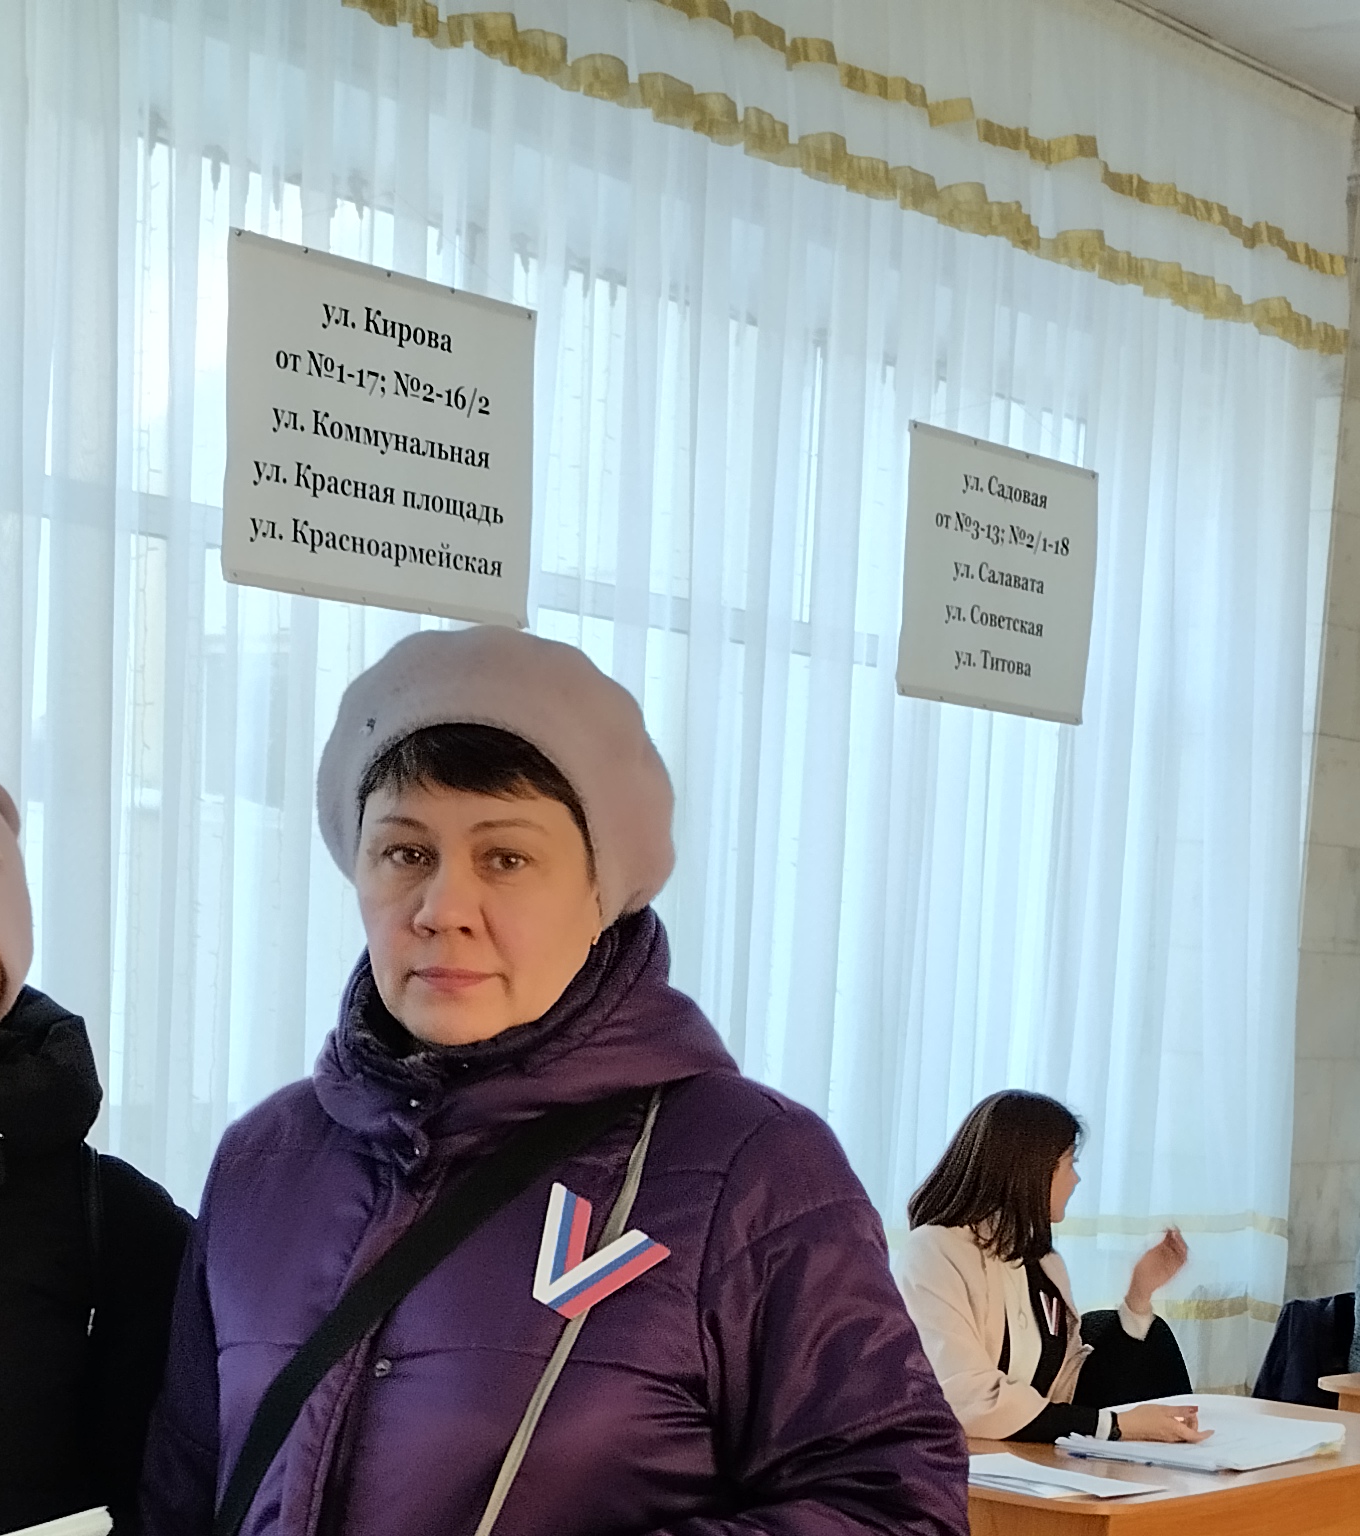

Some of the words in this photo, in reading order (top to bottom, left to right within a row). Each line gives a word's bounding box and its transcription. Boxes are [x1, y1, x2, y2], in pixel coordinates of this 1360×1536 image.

[321, 303, 356, 330] ул.
[364, 306, 453, 354] Кирова
[275, 350, 302, 373] от
[272, 407, 305, 433] ул.
[312, 409, 491, 470] Коммунальная
[252, 460, 288, 487] ул.
[294, 461, 396, 506] Красная
[402, 490, 504, 526] площадь
[962, 474, 984, 494] ул.
[987, 475, 1048, 510] Садовая
[935, 512, 952, 529] от
[249, 517, 284, 543] ул.
[291, 517, 503, 578] Красноармейская
[952, 561, 975, 582] ул.
[978, 561, 1044, 595] Салавата
[944, 604, 966, 625] ул.
[970, 604, 1044, 637] Советская
[954, 650, 977, 670] ул.
[980, 649, 1032, 677] Титова
